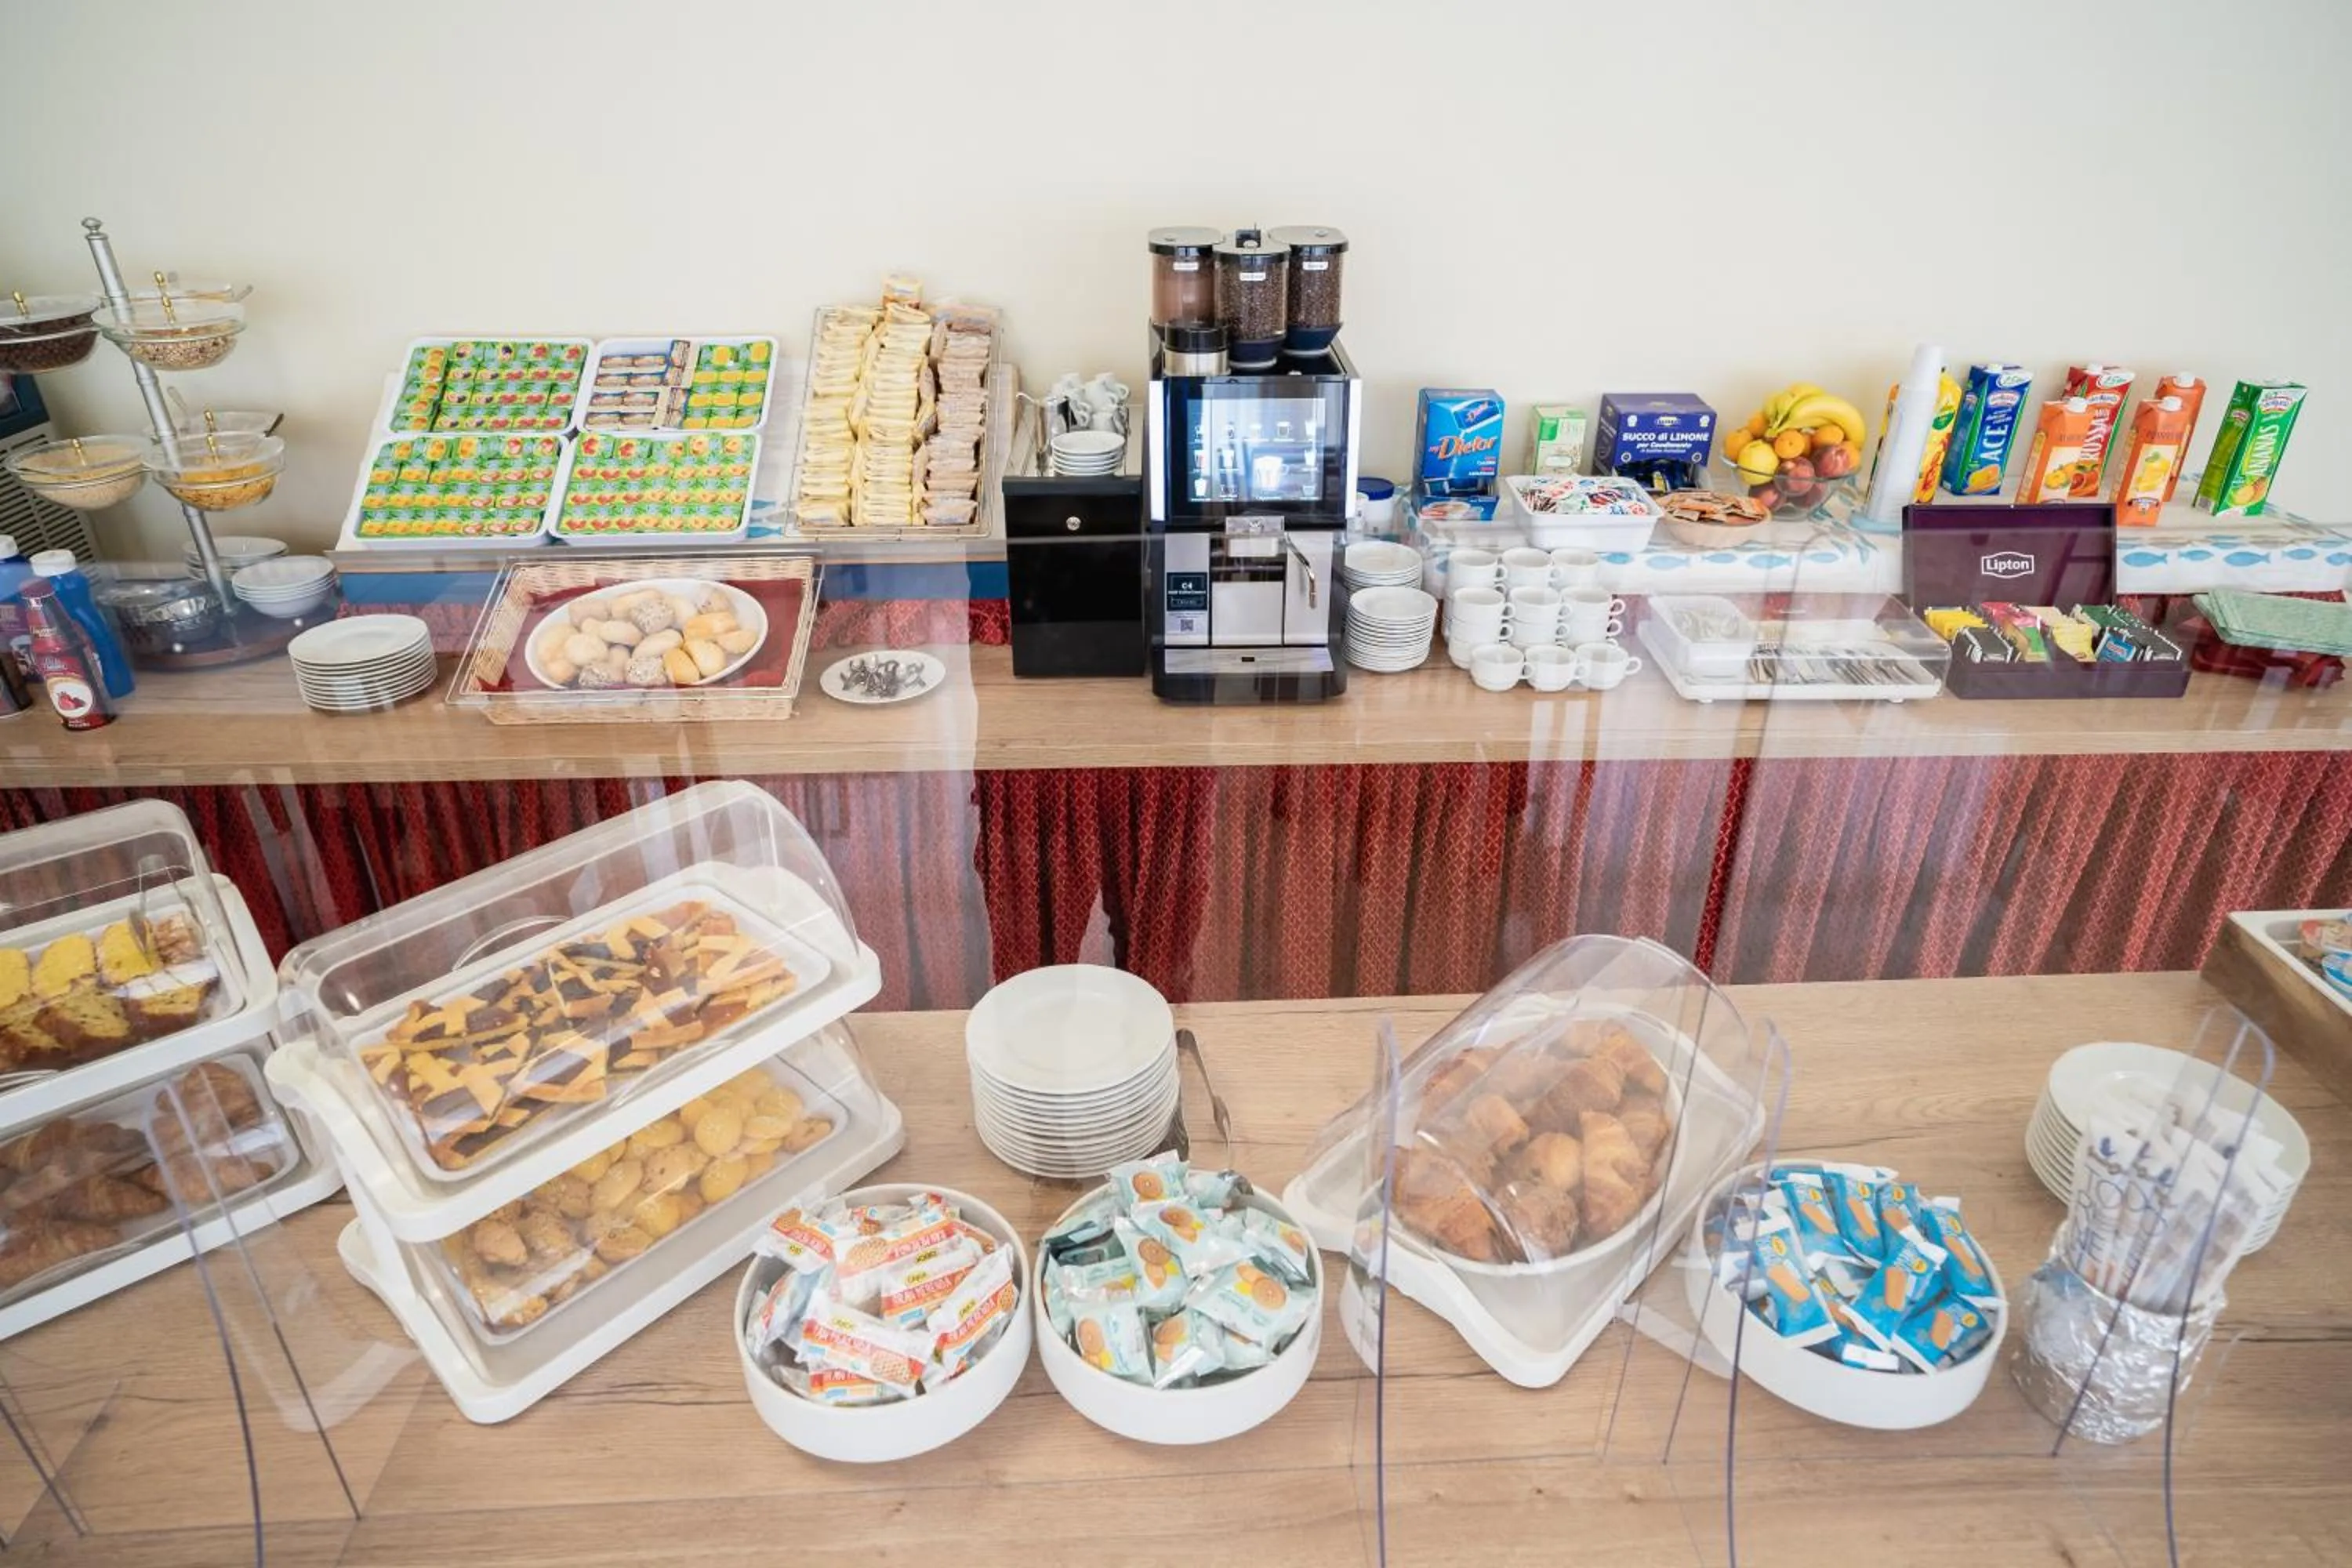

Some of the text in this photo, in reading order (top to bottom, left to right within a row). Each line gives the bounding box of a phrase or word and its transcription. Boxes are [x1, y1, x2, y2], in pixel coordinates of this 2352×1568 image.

[1437, 435, 1498, 461] Dietor
[1622, 432, 1710, 441] SUCCO di LIMONE
[1980, 424, 2009, 462] ACE
[2244, 424, 2280, 477] ANANAS
[1985, 557, 2031, 572] Lipton
